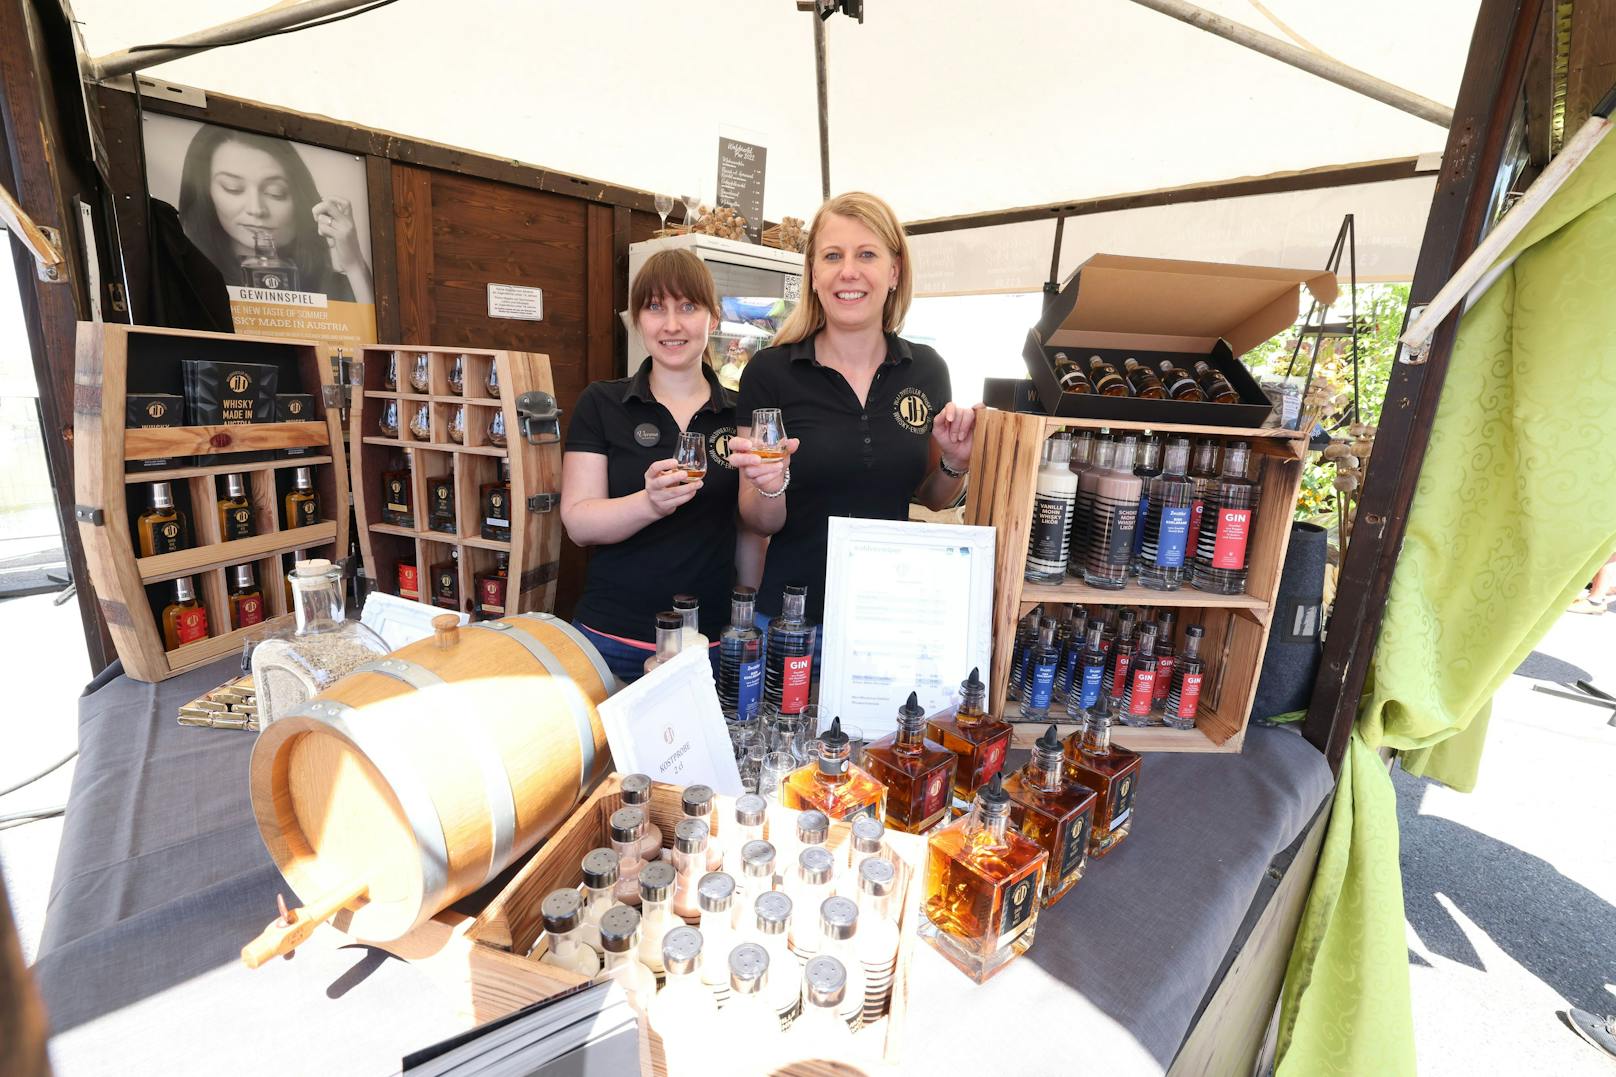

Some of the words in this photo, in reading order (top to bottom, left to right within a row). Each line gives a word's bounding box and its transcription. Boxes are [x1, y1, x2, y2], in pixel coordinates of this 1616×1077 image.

[240, 289, 314, 304] GEWINNSPIEL
[243, 306, 260, 315] NEW
[262, 308, 285, 316] TASTE
[232, 316, 256, 326] SKY
[259, 318, 292, 328] MADE
[293, 320, 304, 328] IN
[306, 321, 348, 332] AUSTRIA
[223, 400, 254, 409] WHISKY
[222, 410, 244, 419] MADE
[245, 410, 252, 419] IN
[1226, 514, 1246, 522] GIN
[790, 660, 808, 669] GIN
[660, 741, 690, 773] KOSTPROBE
